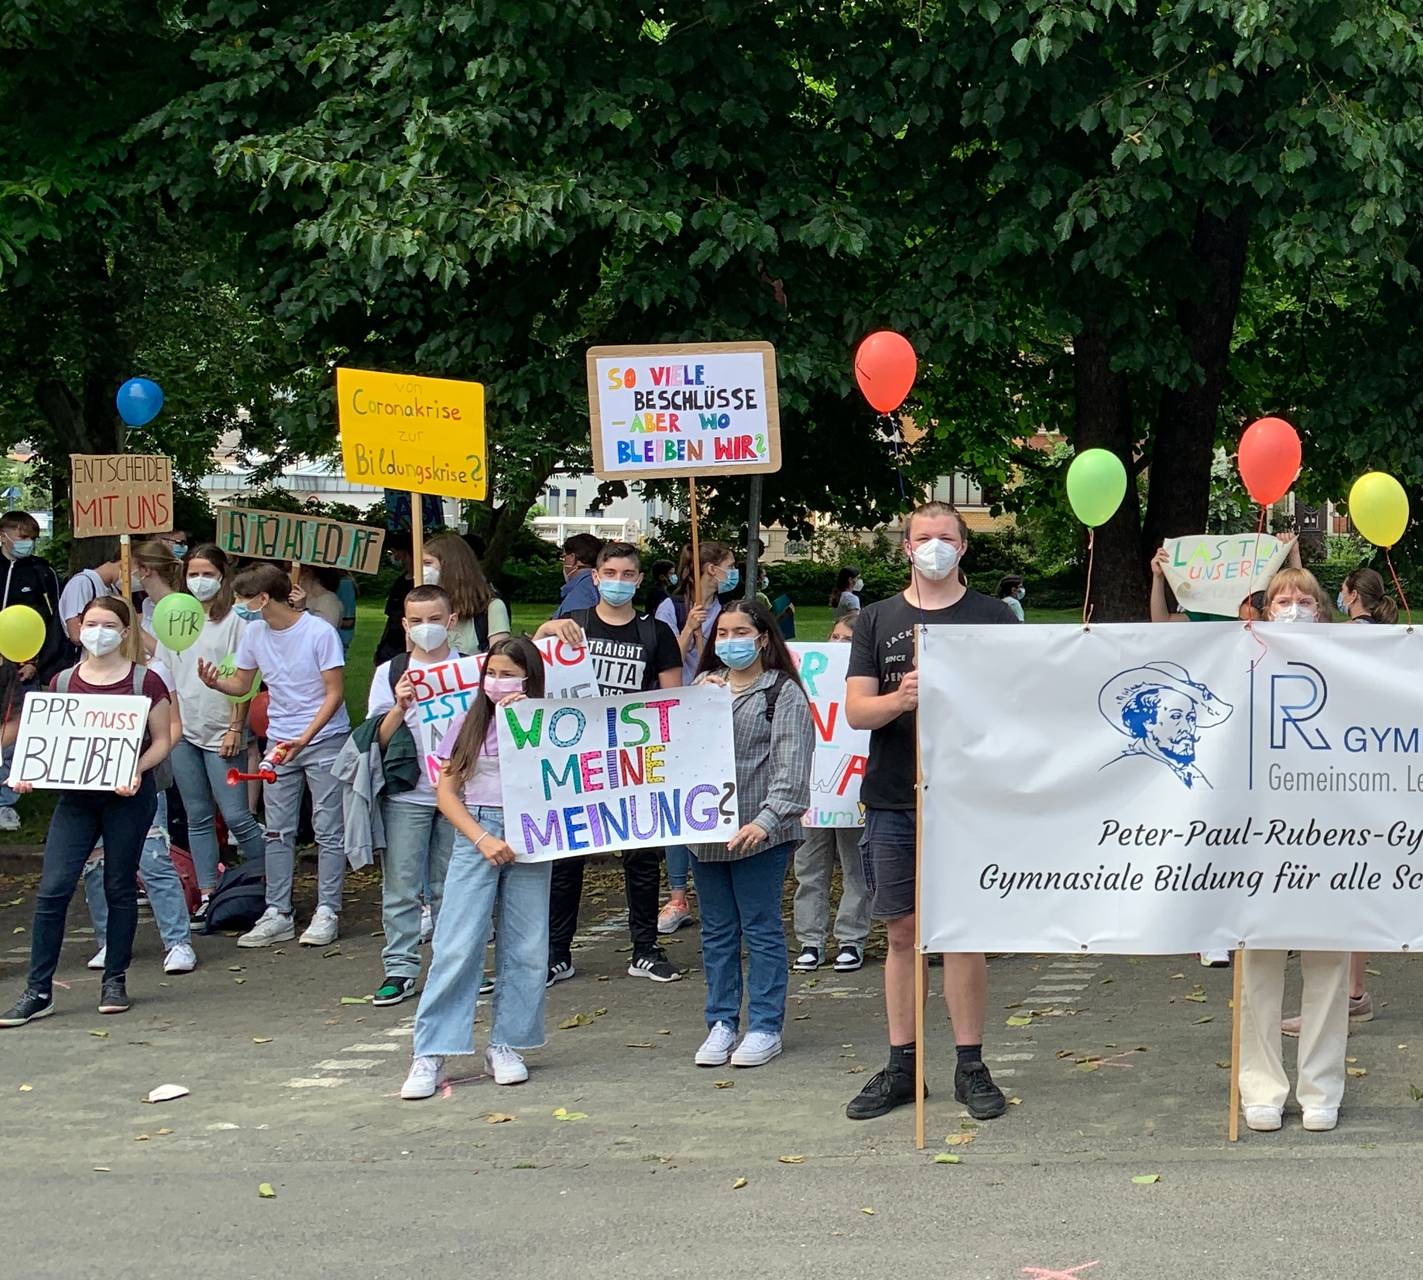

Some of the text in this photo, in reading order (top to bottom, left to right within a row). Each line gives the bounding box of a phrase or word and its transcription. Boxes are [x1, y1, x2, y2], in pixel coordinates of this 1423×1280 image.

[395, 382, 423, 395] von
[608, 365, 705, 390] SO VIELE
[353, 389, 462, 421] Coronakrise
[634, 385, 758, 411] BESCHLÜSSE
[398, 430, 424, 442] zur
[699, 413, 731, 430] WO
[617, 433, 767, 464] BLEIBEN WIR?
[74, 456, 169, 483] ENTSCHEIDET
[354, 444, 483, 488] Bildungskrise?
[76, 493, 169, 530] MIT UNS
[169, 611, 200, 636] PPR
[588, 640, 643, 660] TRAIGHT
[592, 658, 638, 686] UTTA
[27, 698, 138, 730] PPR muss
[504, 706, 587, 750] WO
[606, 699, 680, 748] IST
[20, 736, 140, 787] BLEIBEN
[541, 745, 666, 801] MEINE
[1268, 763, 1397, 793] Gemeinsam.
[520, 782, 736, 854] MEINUNG?
[979, 863, 1144, 899] Gymnasiale
[1154, 862, 1264, 897] Bildung
[1272, 861, 1321, 894] für
[1329, 862, 1382, 890] alle
